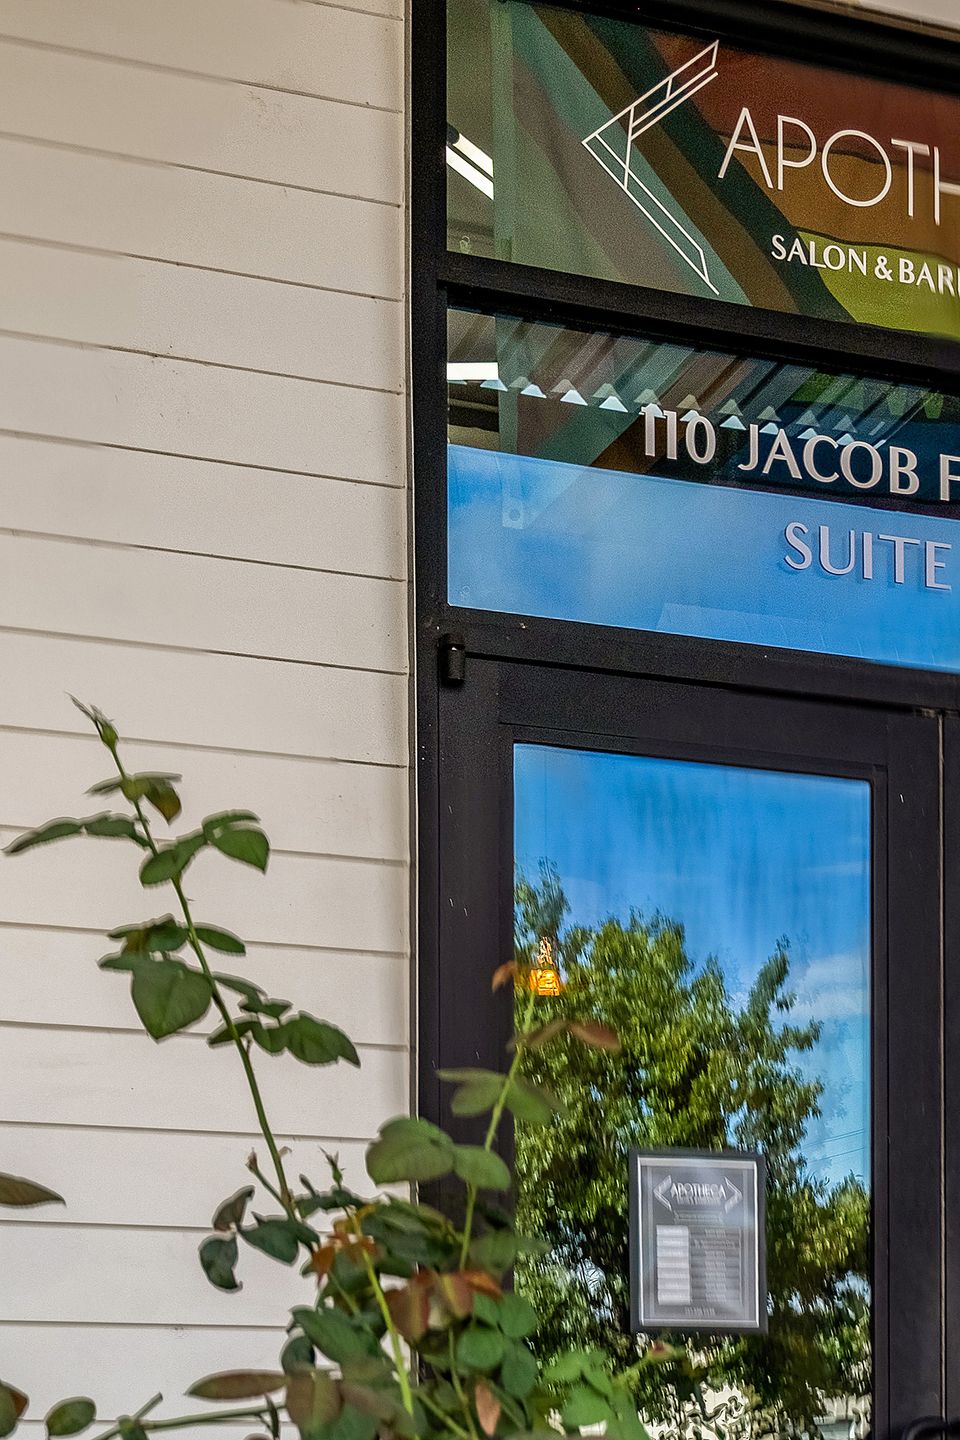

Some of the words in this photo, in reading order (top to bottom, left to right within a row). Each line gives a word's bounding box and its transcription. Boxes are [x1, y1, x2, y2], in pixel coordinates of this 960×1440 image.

[771, 234, 867, 276] SALON
[873, 255, 894, 282] &
[640, 405, 717, 465] 110
[738, 423, 920, 495] JACOB
[783, 521, 952, 591] SUITE
